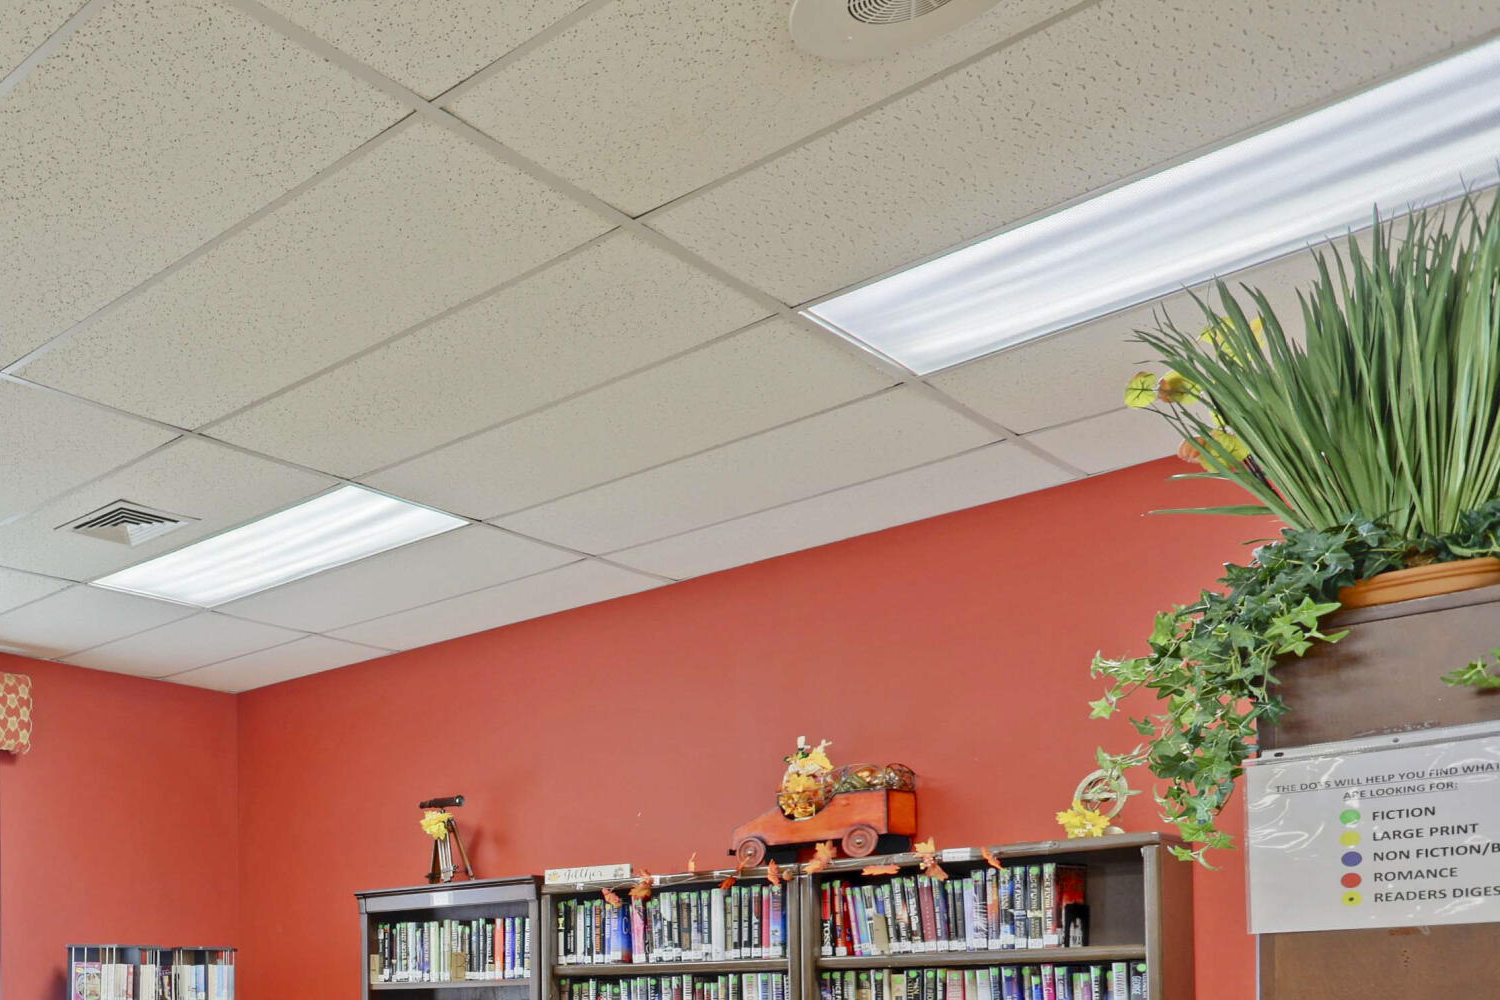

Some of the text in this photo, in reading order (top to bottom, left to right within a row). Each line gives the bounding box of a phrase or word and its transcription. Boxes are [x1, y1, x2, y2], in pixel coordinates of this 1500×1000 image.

[1276, 784, 1297, 792] THE
[1334, 778, 1362, 787] WILL
[1366, 774, 1395, 784] HELP
[1398, 770, 1425, 780] YOU
[1429, 767, 1458, 777] FIND
[1370, 784, 1426, 798] LOOKING
[1372, 806, 1436, 822] FICTION
[1372, 823, 1479, 842] LARGE PRINT
[1373, 849, 1410, 862] NON
[1374, 867, 1458, 882] ROMANCE
[1374, 888, 1447, 902] READERS
